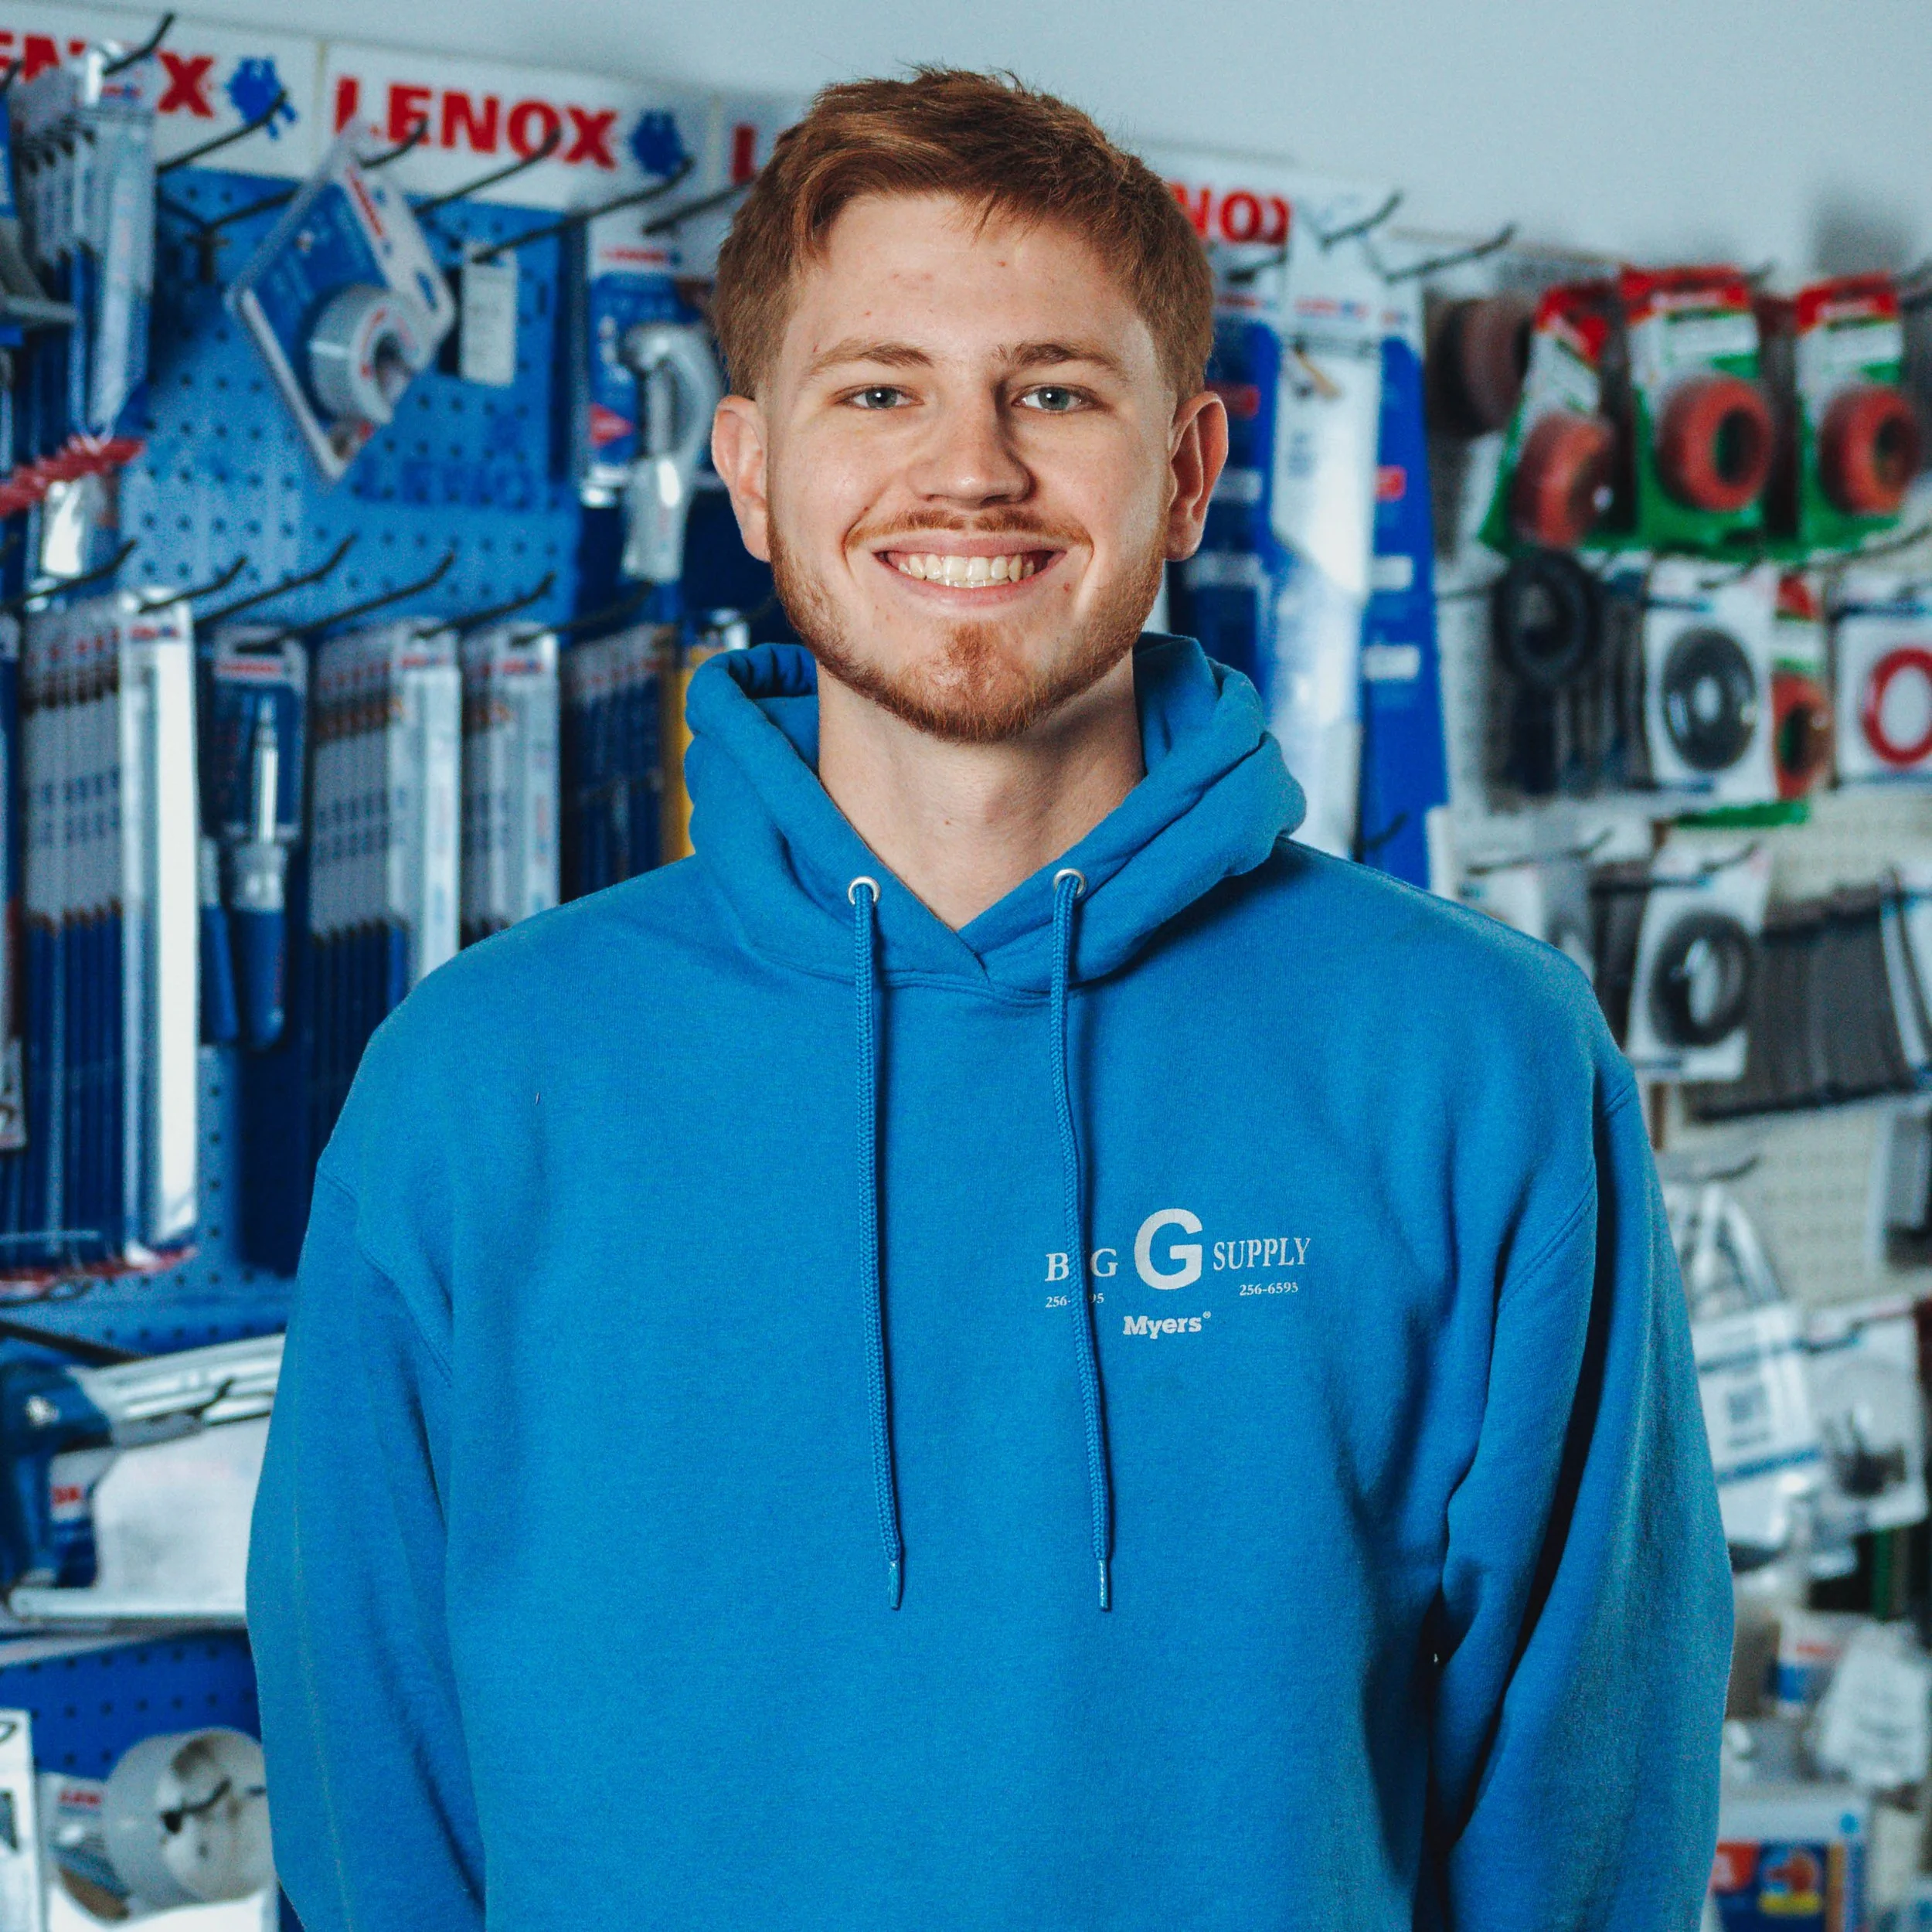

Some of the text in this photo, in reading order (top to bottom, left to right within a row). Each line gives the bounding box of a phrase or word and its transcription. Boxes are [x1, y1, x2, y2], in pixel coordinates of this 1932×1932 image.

[334, 77, 617, 172] LENOX
[1045, 1208, 1311, 1291] BG G SUPPLY
